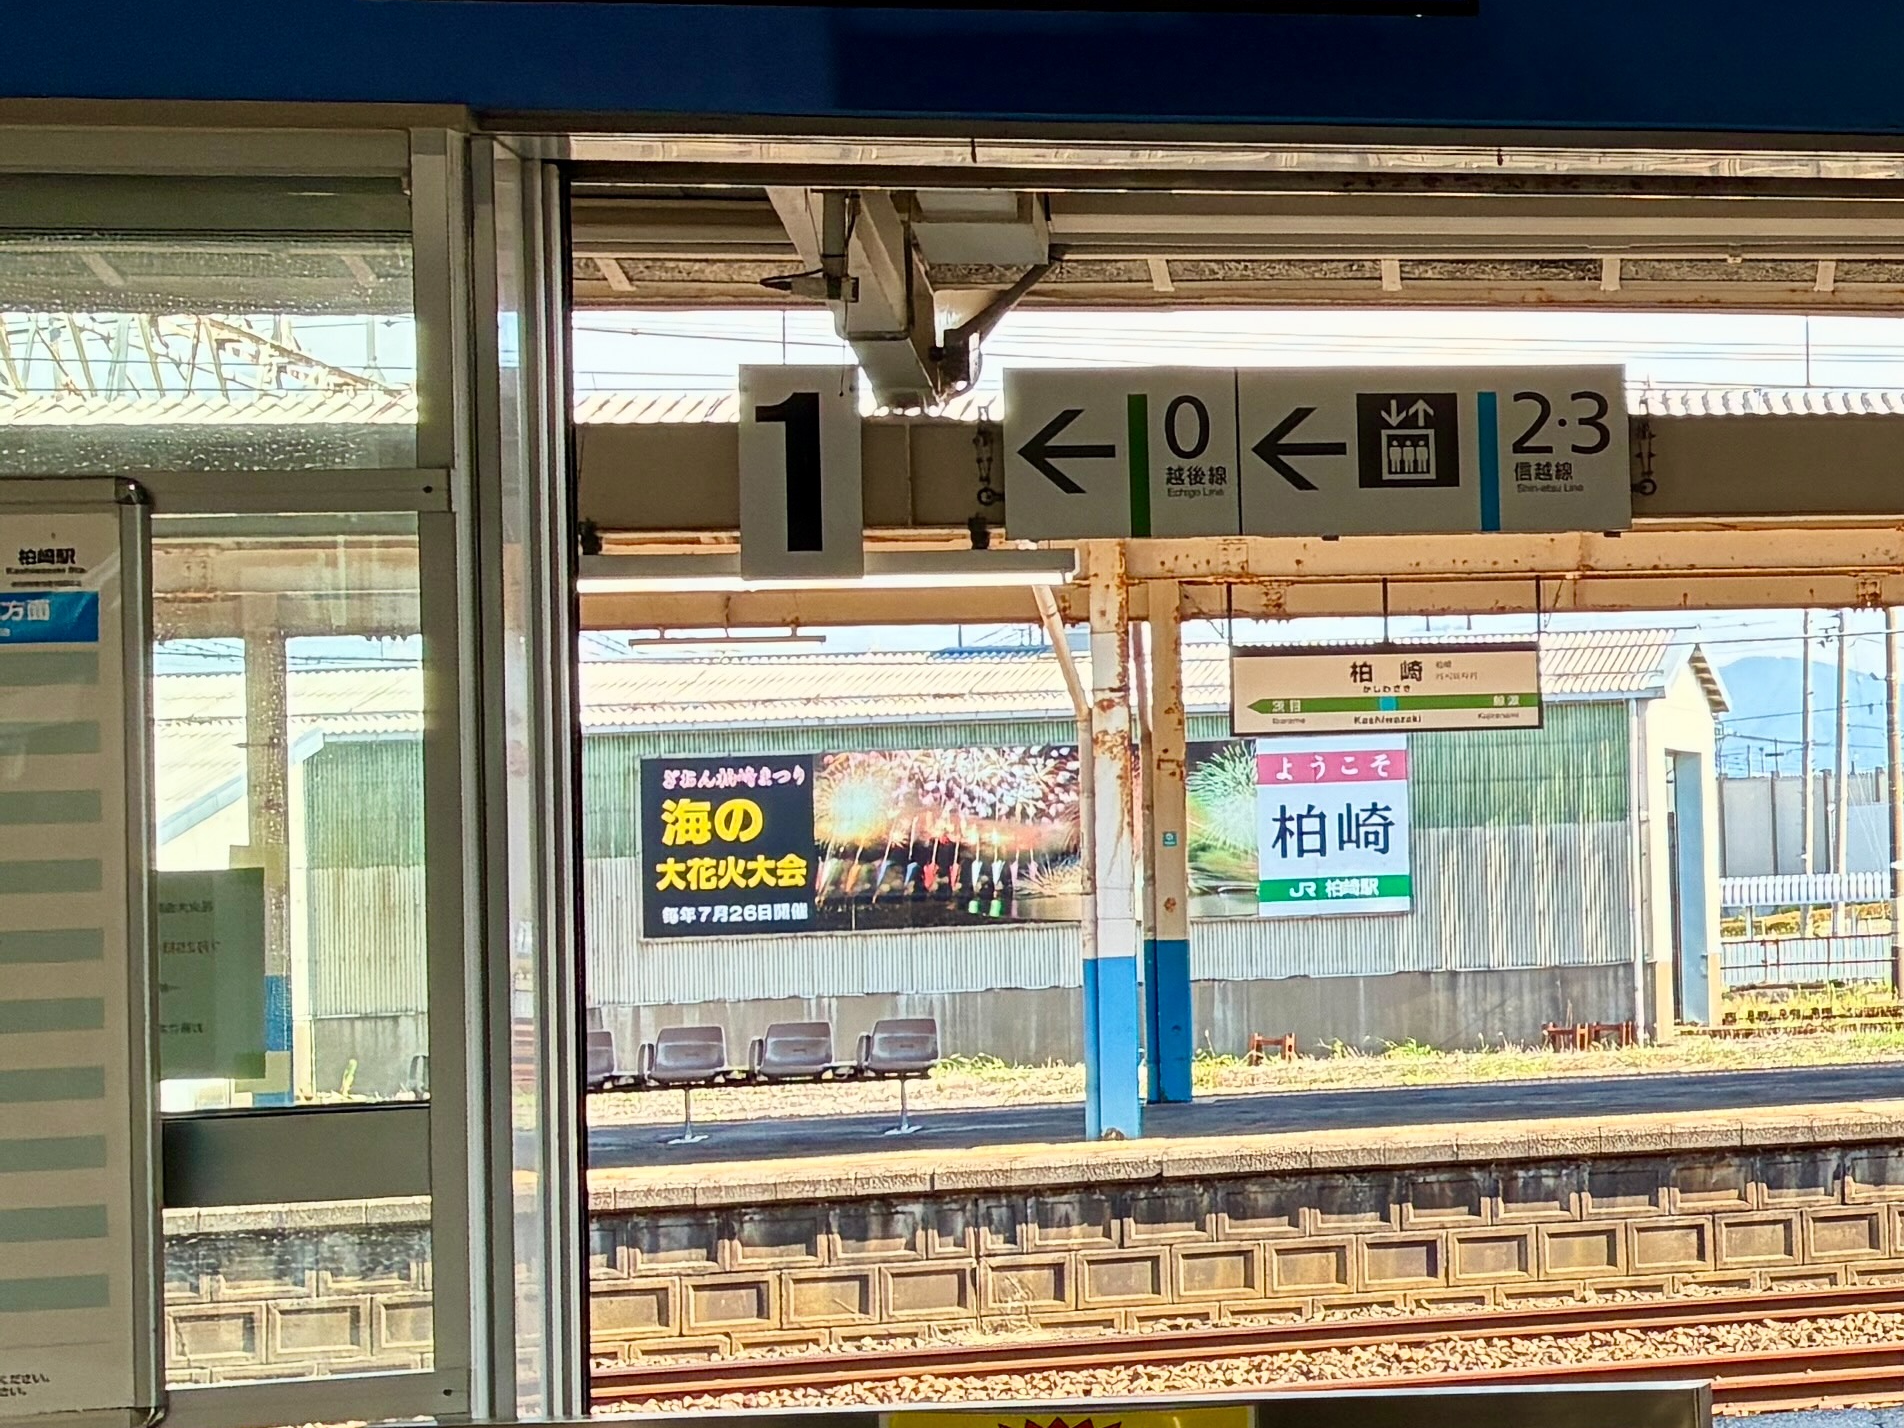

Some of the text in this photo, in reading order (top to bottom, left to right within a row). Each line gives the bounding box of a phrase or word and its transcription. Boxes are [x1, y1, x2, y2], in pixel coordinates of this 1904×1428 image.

[1164, 395, 1210, 458] 0
[755, 392, 823, 552] 1
[1165, 465, 1228, 488] 越後線
[1514, 461, 1574, 483] 信越線
[1350, 660, 1423, 684] 柏崎
[1276, 753, 1392, 781] ようこそ
[661, 798, 764, 846] 海の
[1272, 801, 1395, 859] 柏崎
[655, 853, 808, 891] 大花火大会
[1289, 877, 1380, 898] JR 柏崎駅
